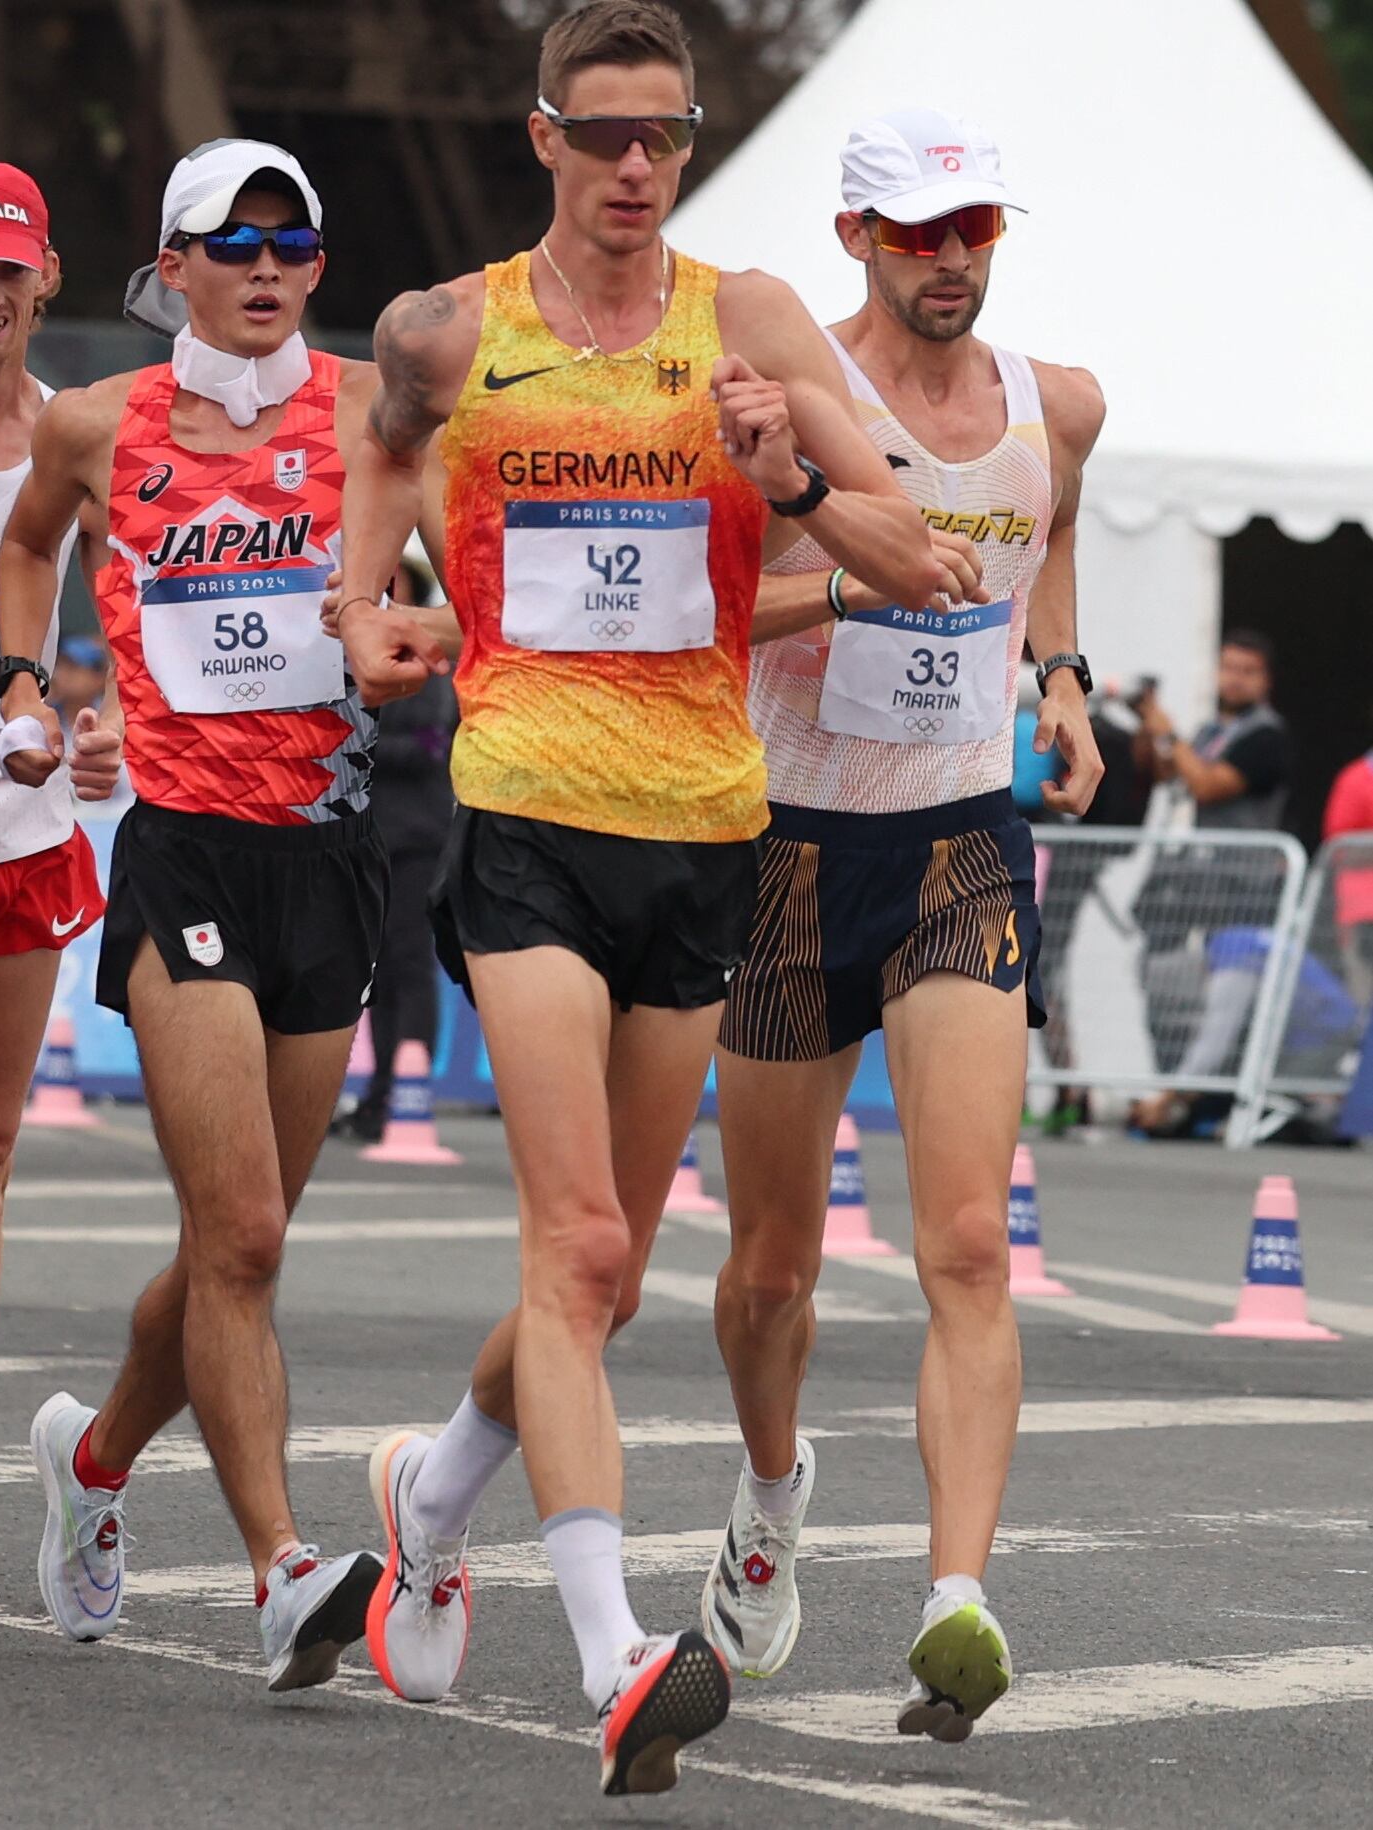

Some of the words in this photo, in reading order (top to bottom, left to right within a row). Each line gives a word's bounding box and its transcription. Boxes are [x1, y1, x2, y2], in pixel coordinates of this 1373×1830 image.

[498, 450, 700, 489] GERMANY
[559, 508, 613, 522] PARIS
[619, 508, 667, 523] 2024
[147, 512, 314, 567] JAPAN
[586, 543, 642, 586] 42
[188, 580, 236, 595] PARIS
[241, 577, 287, 591] 2024
[585, 592, 641, 612] LINKE
[213, 611, 269, 652] 58
[892, 609, 944, 630] PARIS
[950, 614, 981, 631] 2024
[201, 653, 287, 677] KAWANO
[906, 647, 960, 688] 33
[892, 688, 961, 711] MARTIN
